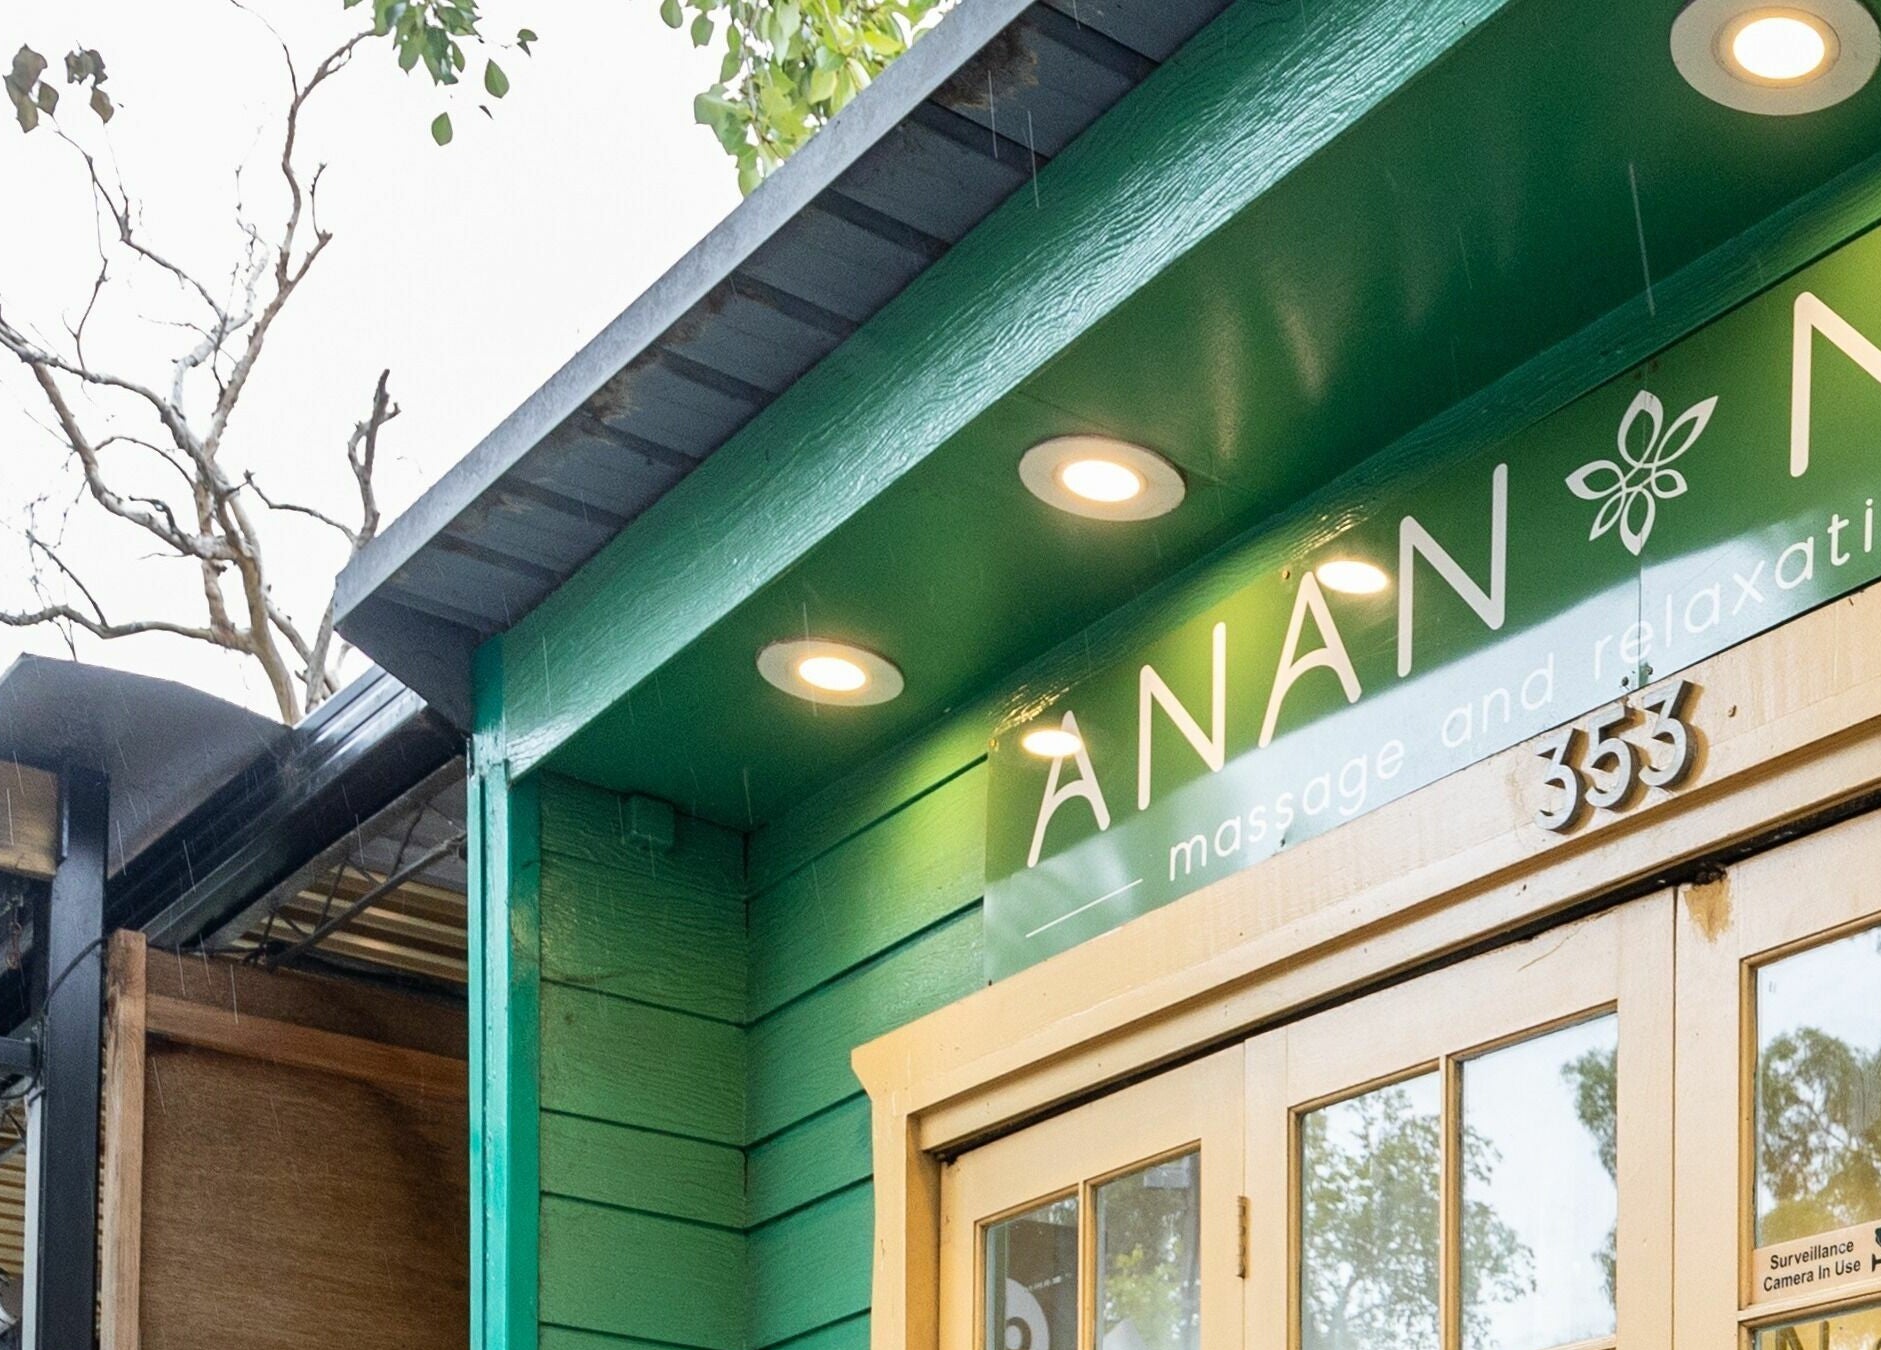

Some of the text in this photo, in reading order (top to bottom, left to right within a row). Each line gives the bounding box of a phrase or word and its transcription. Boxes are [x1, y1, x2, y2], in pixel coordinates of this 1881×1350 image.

[1027, 463, 1508, 868] ANAN
[1169, 737, 1405, 882] massage
[1440, 652, 1555, 750] and
[1535, 679, 1703, 834] 353
[1763, 1259, 1862, 1292] Camera In Use
[1770, 1240, 1854, 1271] Surveillance
